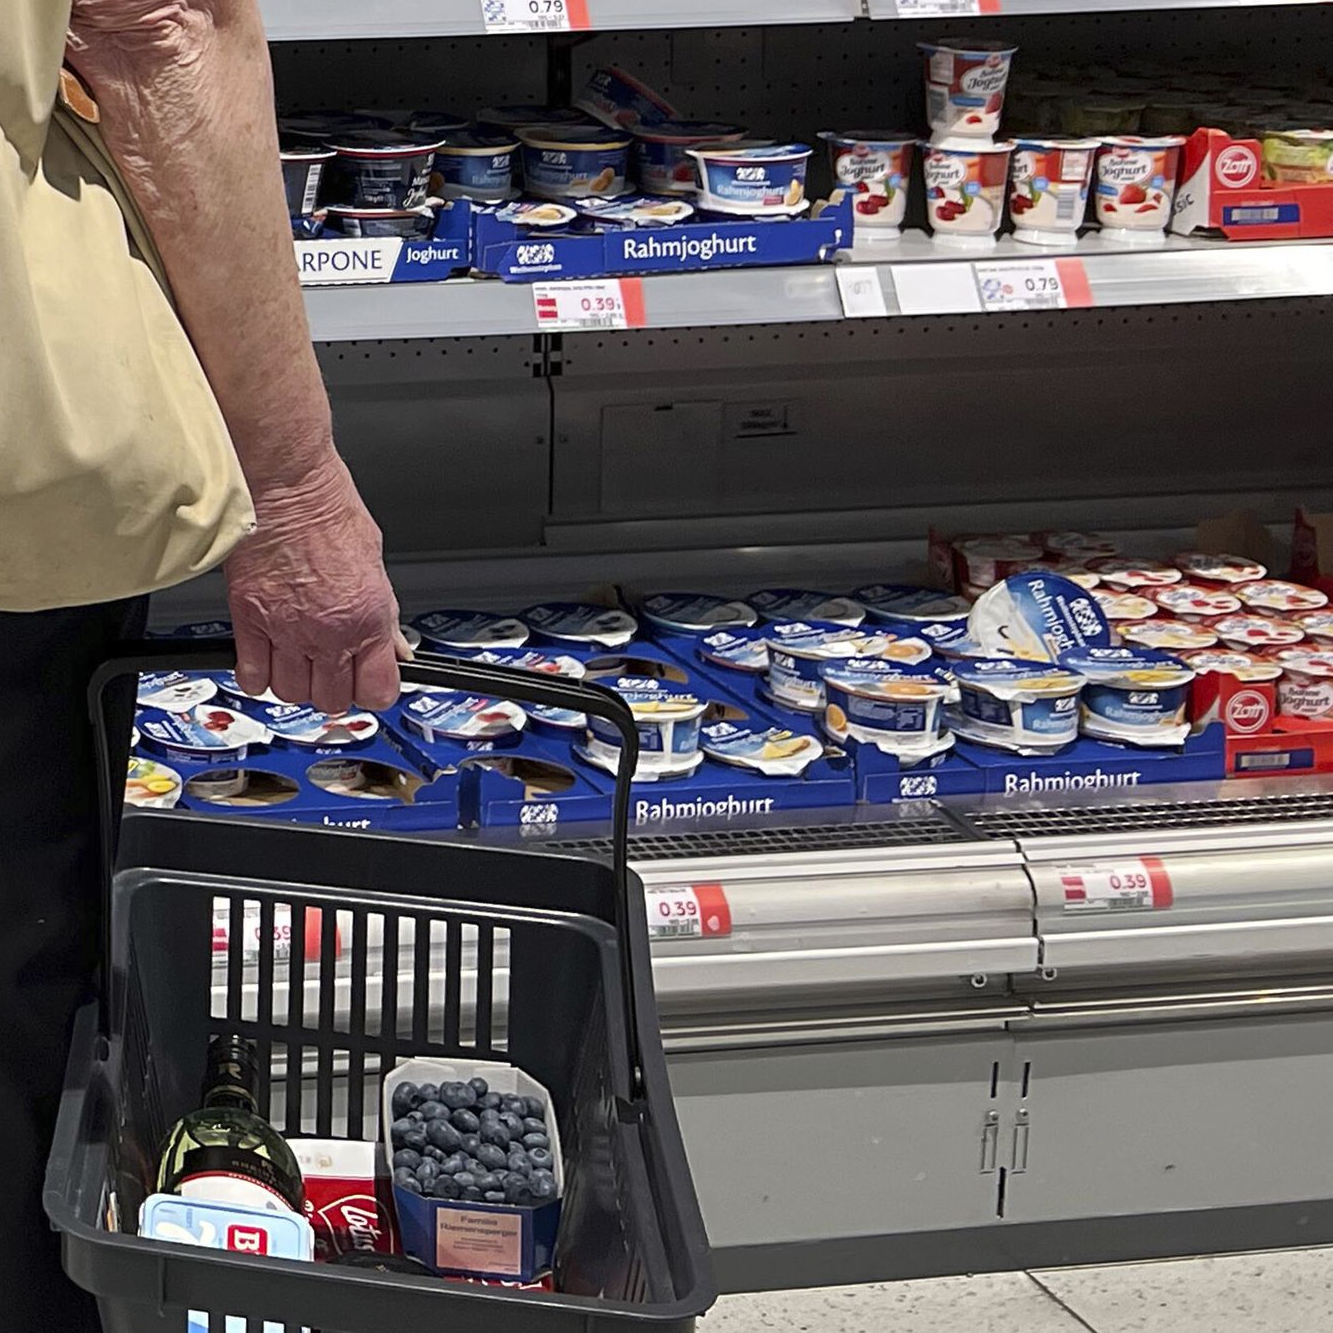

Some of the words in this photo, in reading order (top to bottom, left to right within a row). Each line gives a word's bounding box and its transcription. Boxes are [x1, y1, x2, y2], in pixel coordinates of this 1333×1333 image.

[837, 161, 889, 179] Joghurt
[407, 244, 459, 264] Joghurt
[623, 233, 757, 262] Rahmjoghurt
[1024, 277, 1059, 292] 0.79
[580, 297, 616, 312] 0.39
[1231, 700, 1260, 720] Zott
[1004, 767, 1142, 795] Rahmjoghurt
[634, 794, 774, 820] Rahmjoghurt
[1109, 874, 1147, 889] 0.39
[659, 901, 698, 916] 0.39
[459, 1214, 499, 1226] Familie
[439, 1221, 519, 1239] Riemensperger
